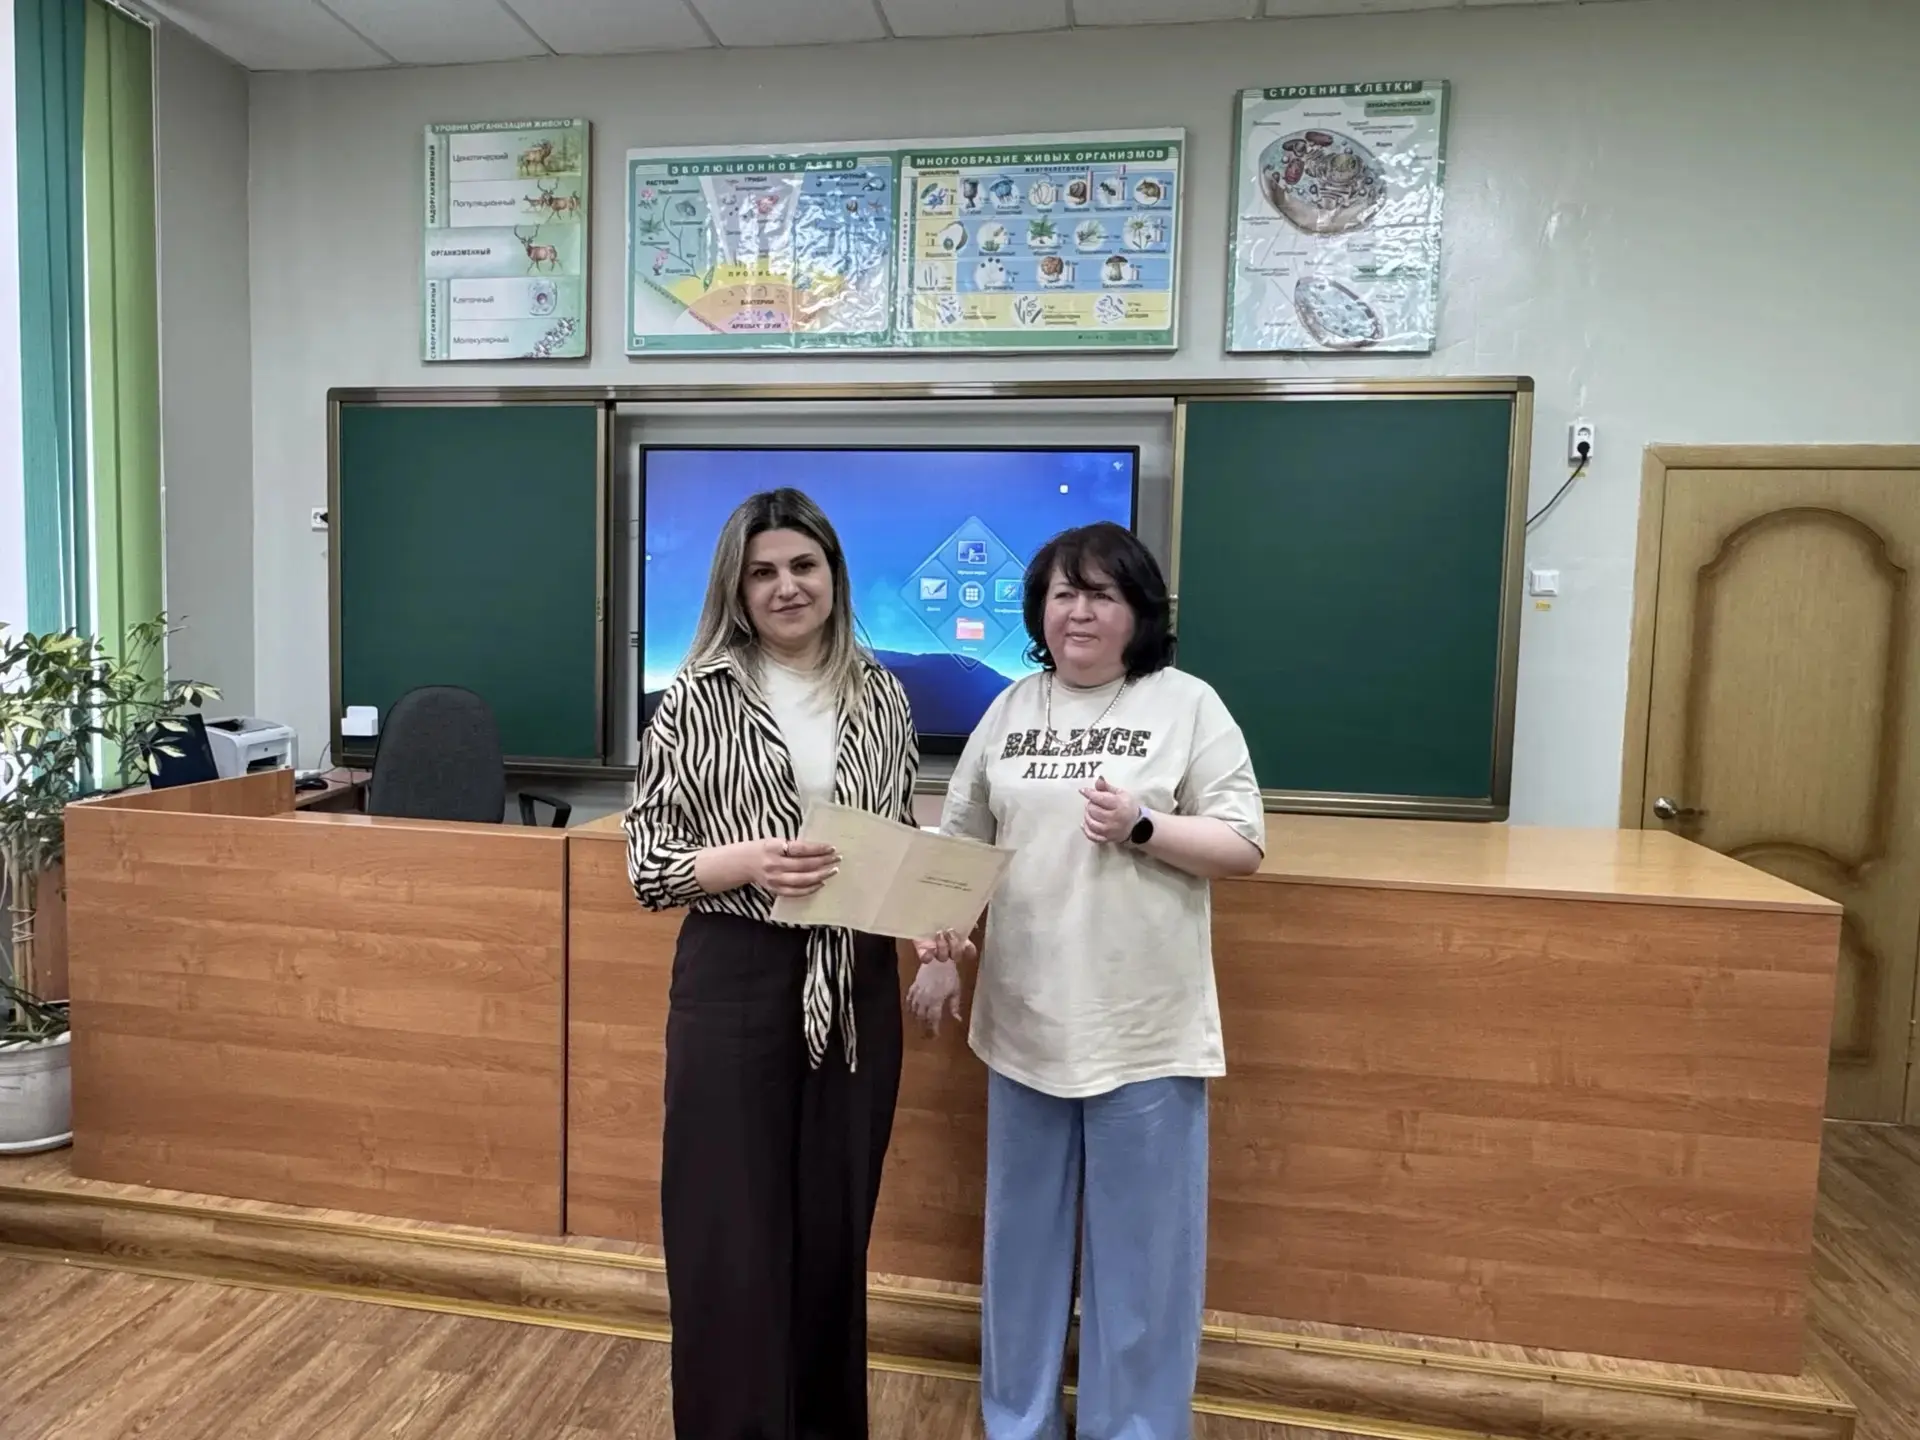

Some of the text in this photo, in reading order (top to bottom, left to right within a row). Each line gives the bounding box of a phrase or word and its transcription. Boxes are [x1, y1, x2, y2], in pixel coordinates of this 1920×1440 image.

[1269, 82, 1413, 97] СТРОЕНИЕ КЛЕТКИ
[471, 122, 533, 131] ОРГАНИЗАЦИИ
[534, 119, 571, 127] ЖИВОГО
[916, 149, 1165, 166] МНОГООБРАЗИЕ ЖИВЫХ ОРГАНИЗМОВ
[671, 163, 796, 174] ЭВОЛЮЦИОННОЕ
[431, 248, 491, 256] ОРГАНИЗМЕННЫЙ
[1000, 726, 1152, 760] BALANCE
[1022, 761, 1103, 779] ALL DAY
